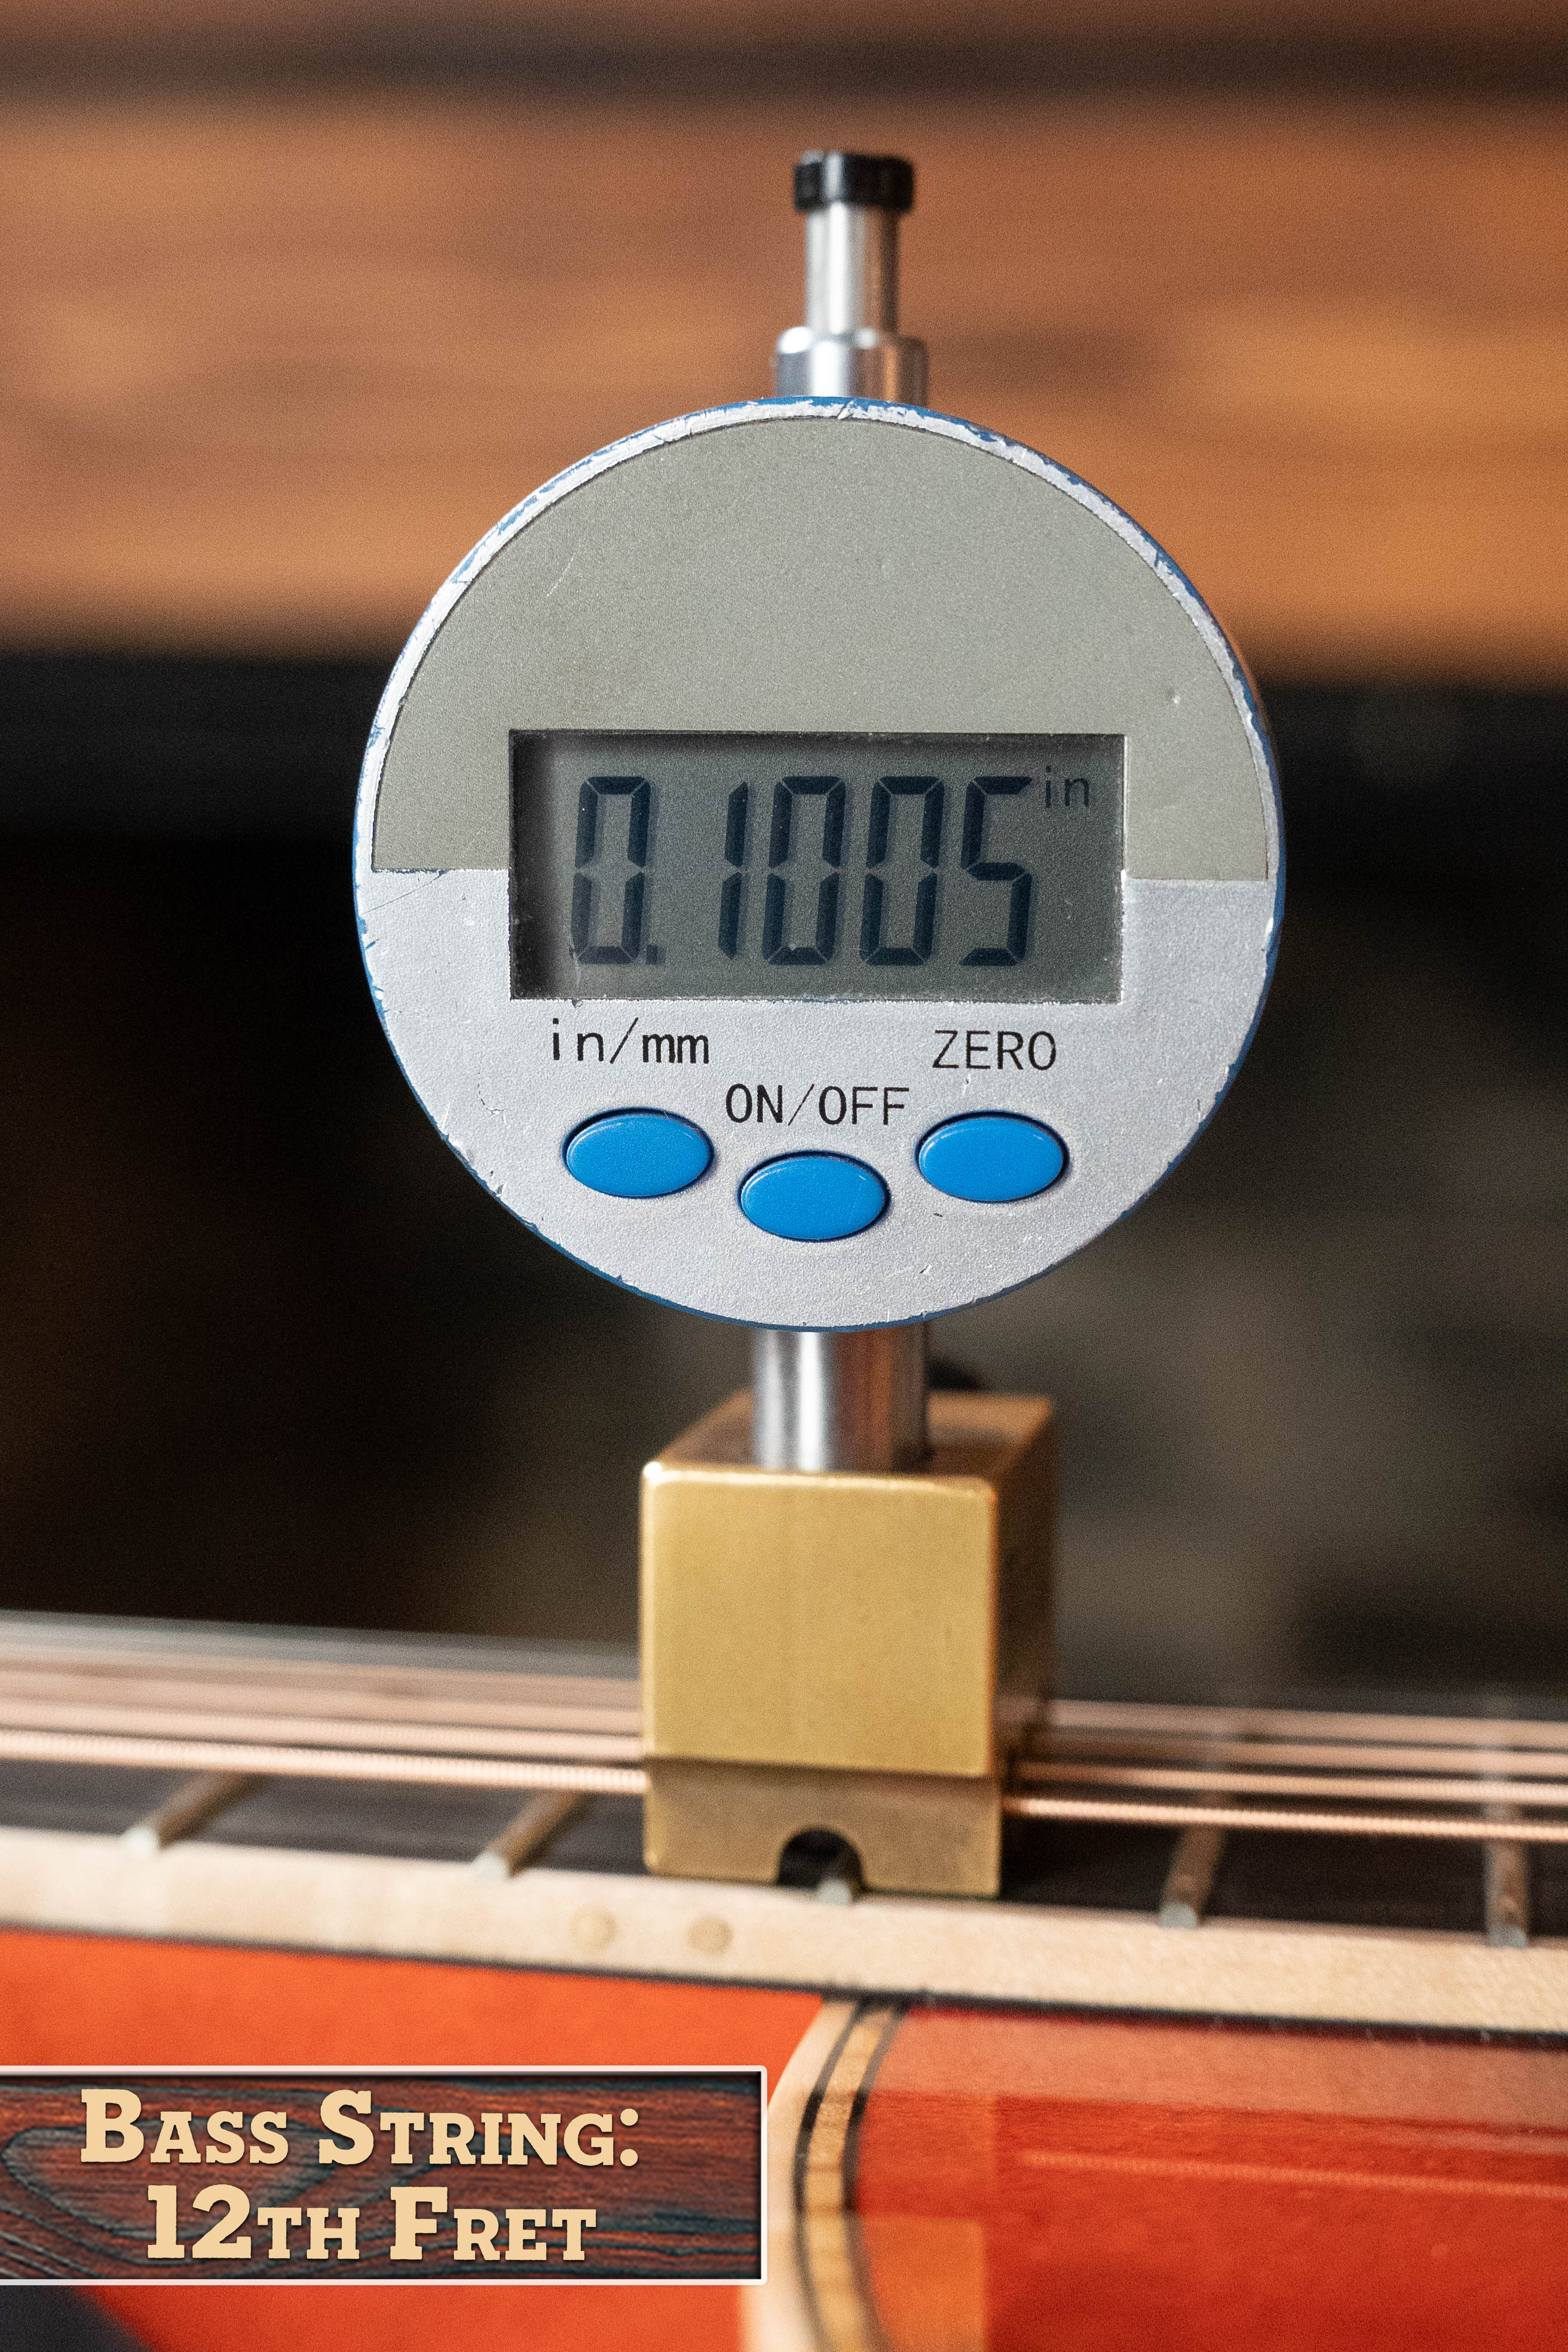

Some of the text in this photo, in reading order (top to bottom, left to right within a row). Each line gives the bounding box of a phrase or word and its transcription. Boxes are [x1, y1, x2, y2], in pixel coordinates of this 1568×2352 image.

[571, 765, 1090, 966] 0.1005 in
[552, 1017, 710, 1064] in/mm
[932, 1029, 1058, 1071] ZERO
[725, 1083, 910, 1126] ON/OFF
